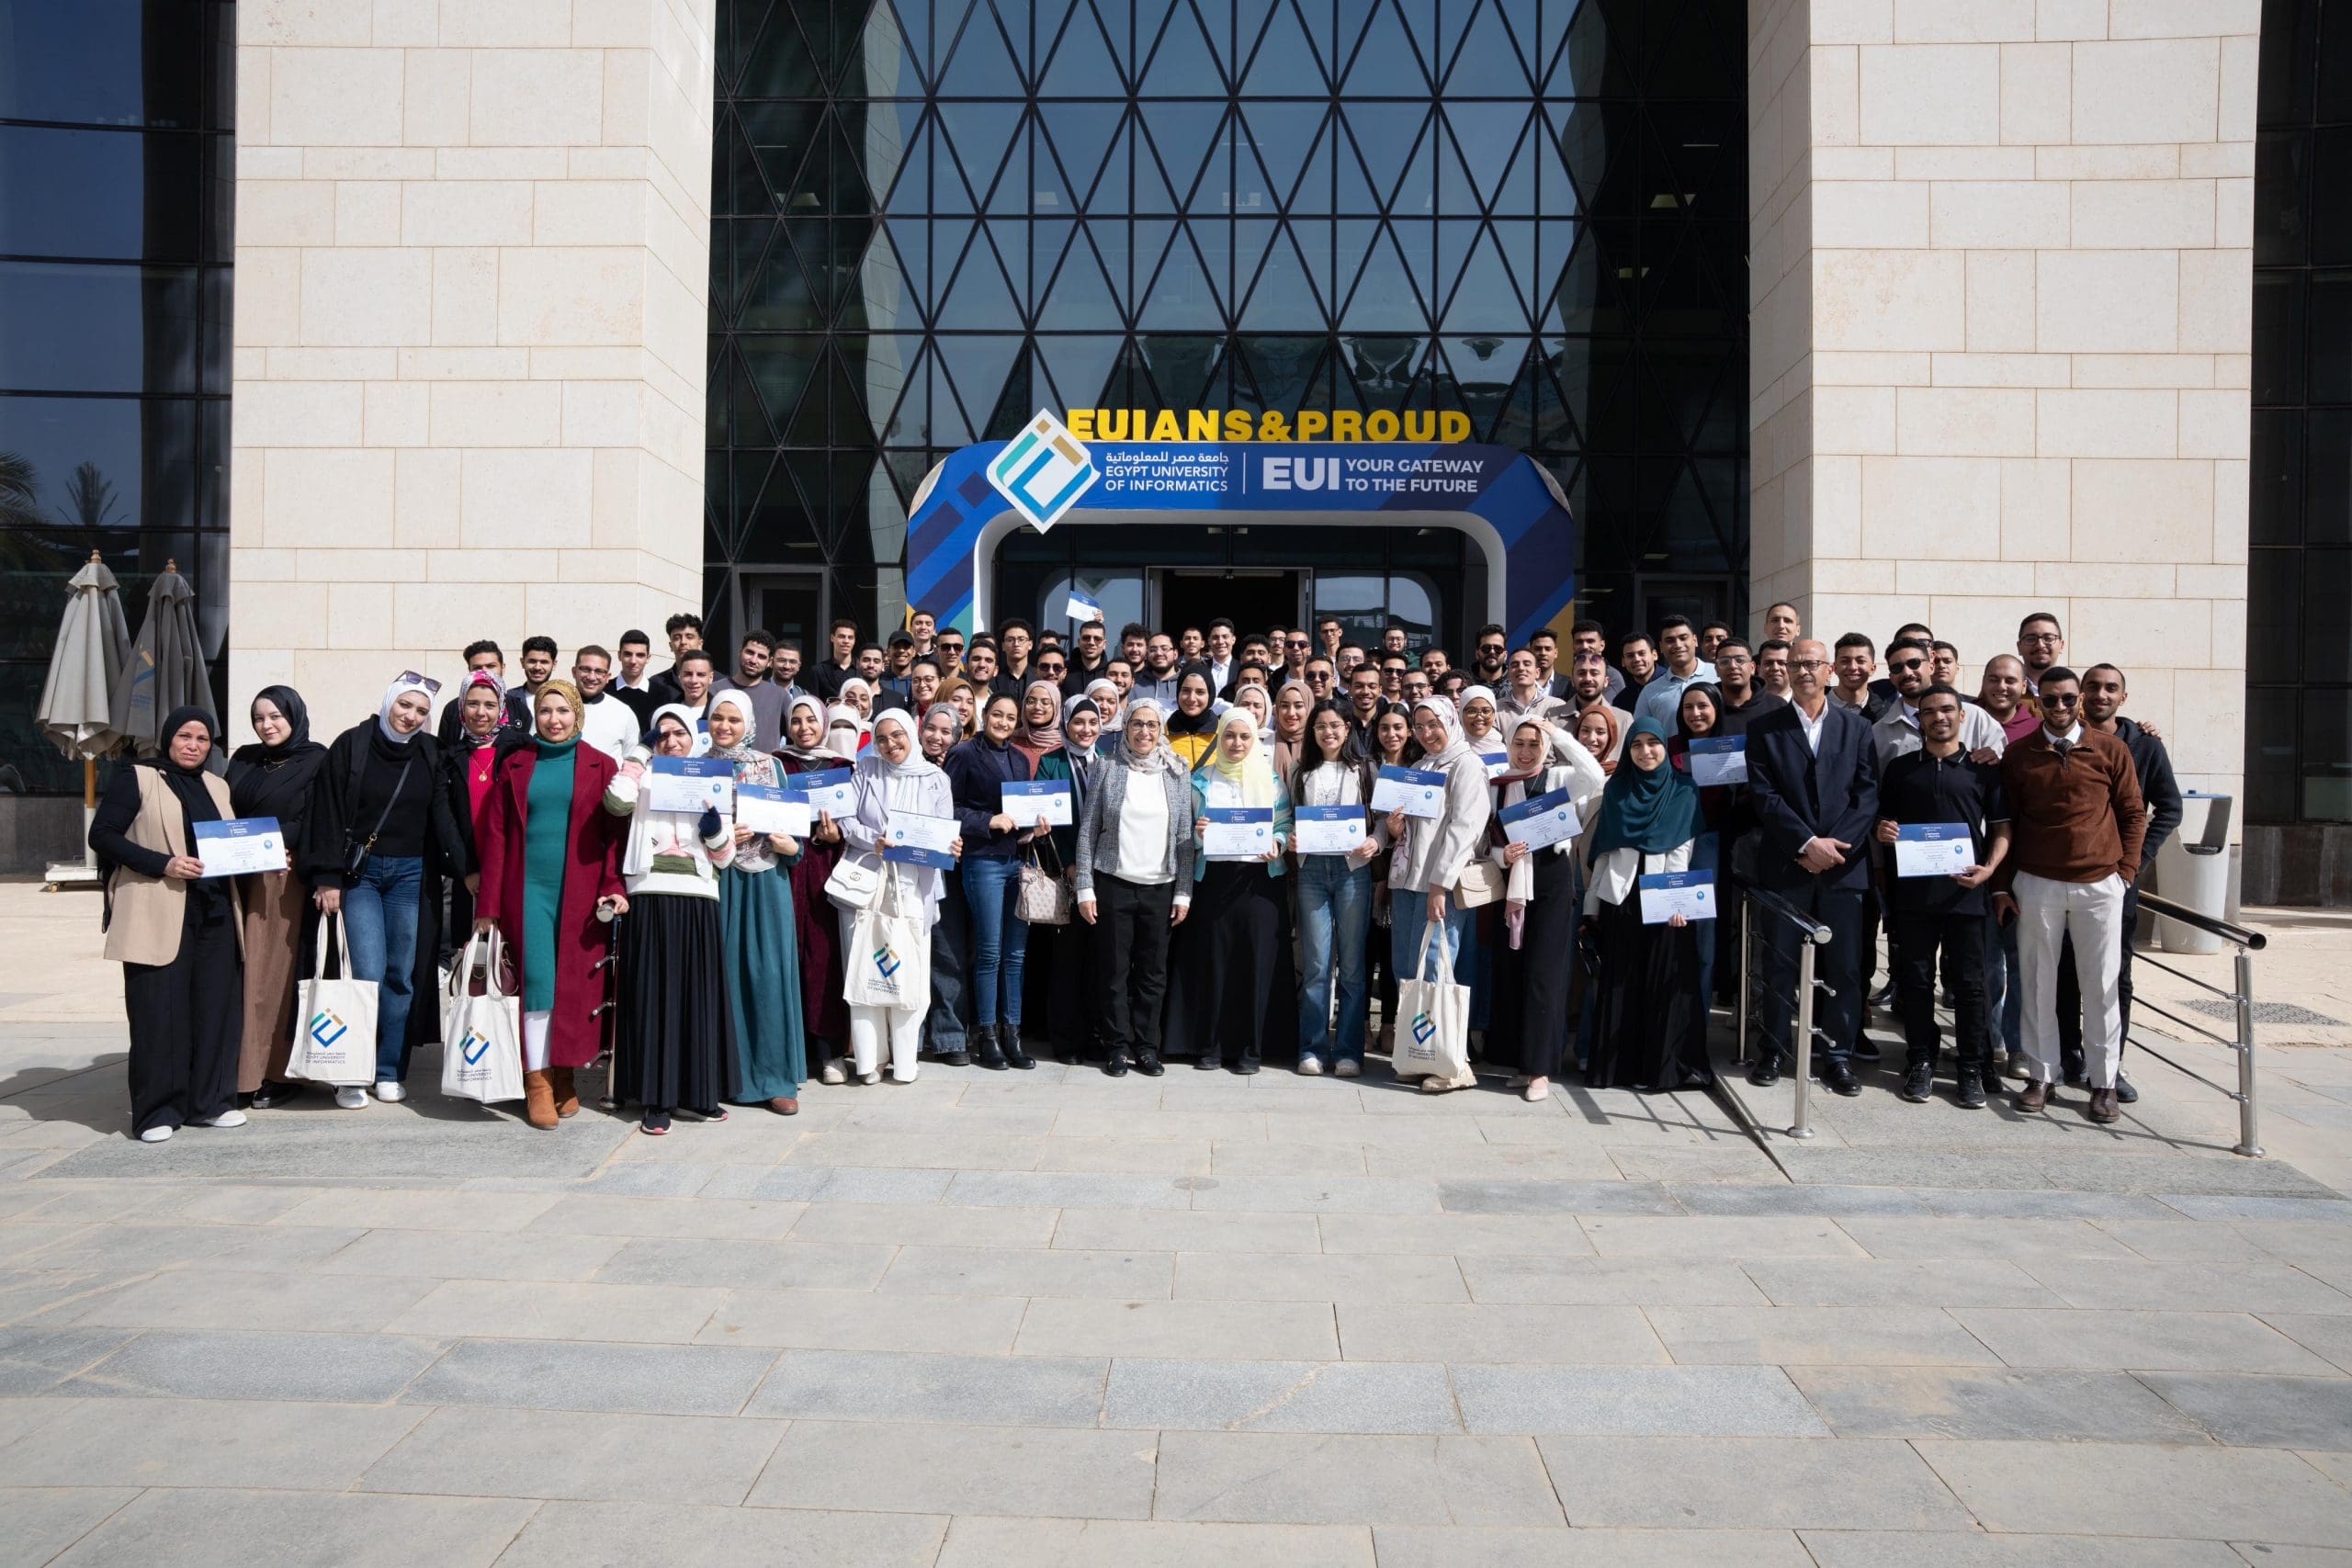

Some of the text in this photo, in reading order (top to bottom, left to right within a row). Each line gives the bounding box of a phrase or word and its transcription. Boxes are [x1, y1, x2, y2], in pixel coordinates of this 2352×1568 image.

[1067, 409, 1471, 442] EUIANS&PROUD
[1105, 451, 1229, 465] جامعة مصر للمعلوماتية
[1346, 458, 1485, 473] YOUR GATEWAY
[1105, 466, 1228, 477] EGYPT UNIVERSITY
[1262, 457, 1340, 491] EUI
[1105, 479, 1228, 491] OF INFORMATICS
[1345, 478, 1478, 493] TO THE FUTURE
